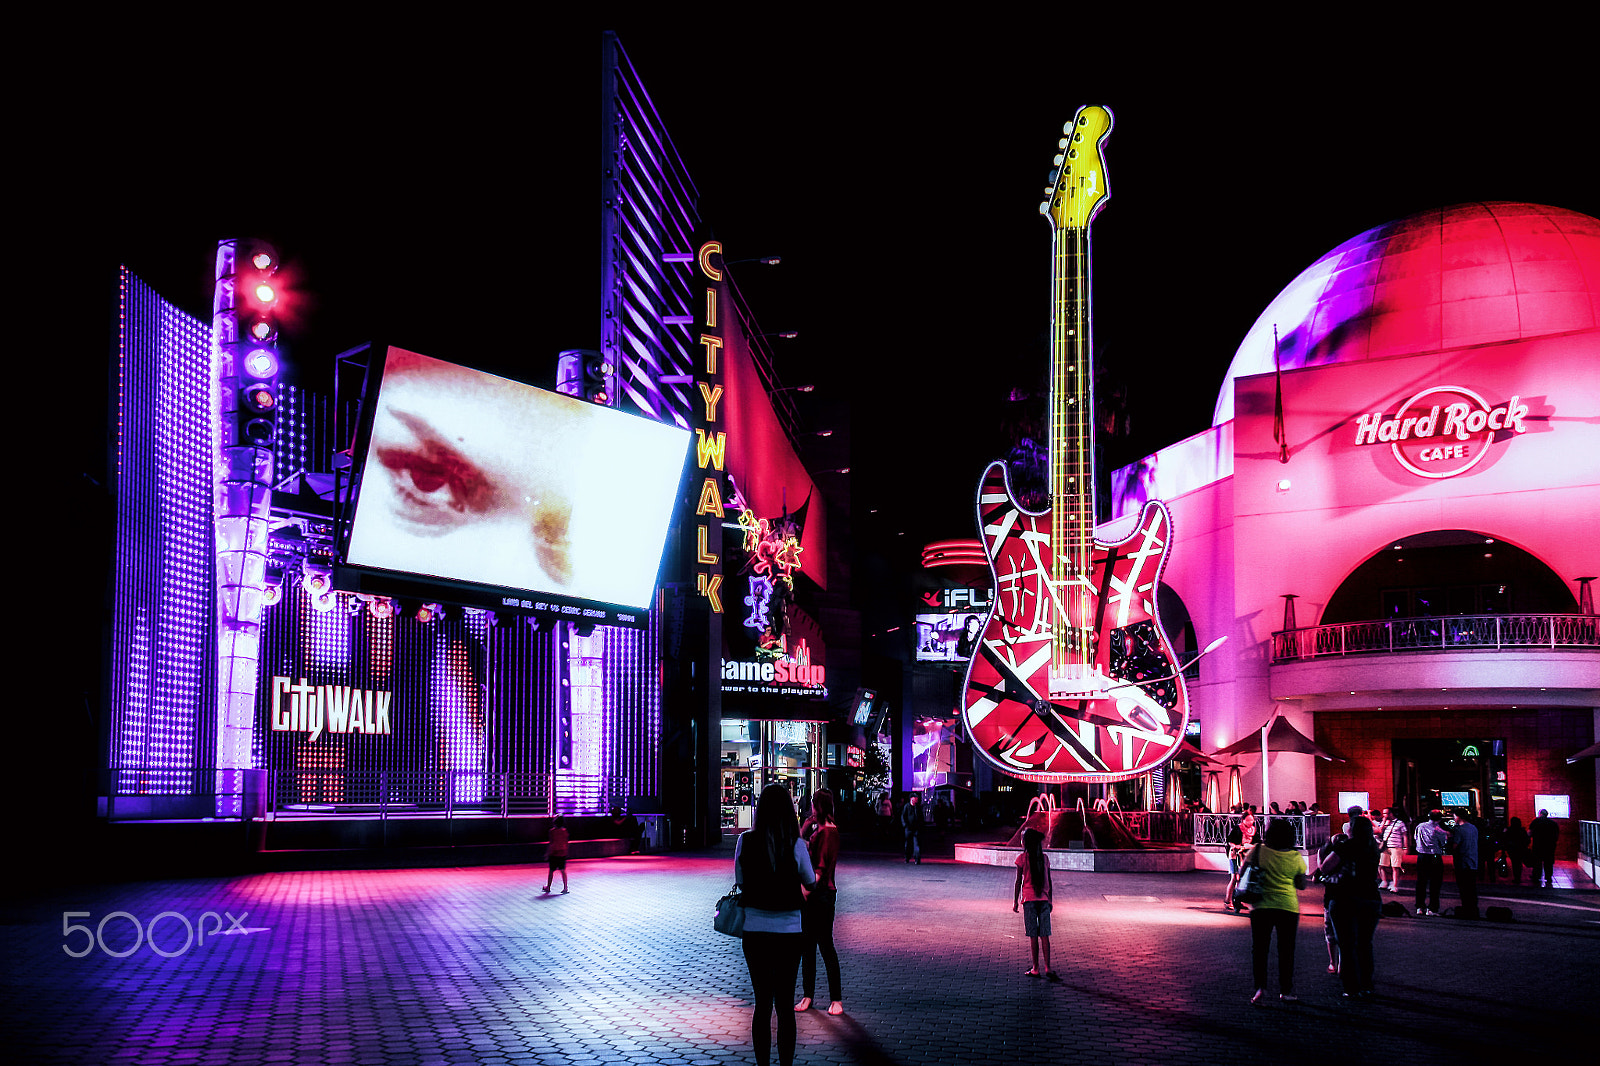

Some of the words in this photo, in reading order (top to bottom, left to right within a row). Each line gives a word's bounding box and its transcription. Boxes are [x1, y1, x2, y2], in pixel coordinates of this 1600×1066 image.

[696, 240, 728, 614] CITYWALK
[1354, 405, 1440, 446] Hard
[1444, 395, 1529, 440] Rock
[1419, 445, 1464, 462] CAFE
[271, 676, 391, 742] CityWALK
[748, 685, 759, 693] to
